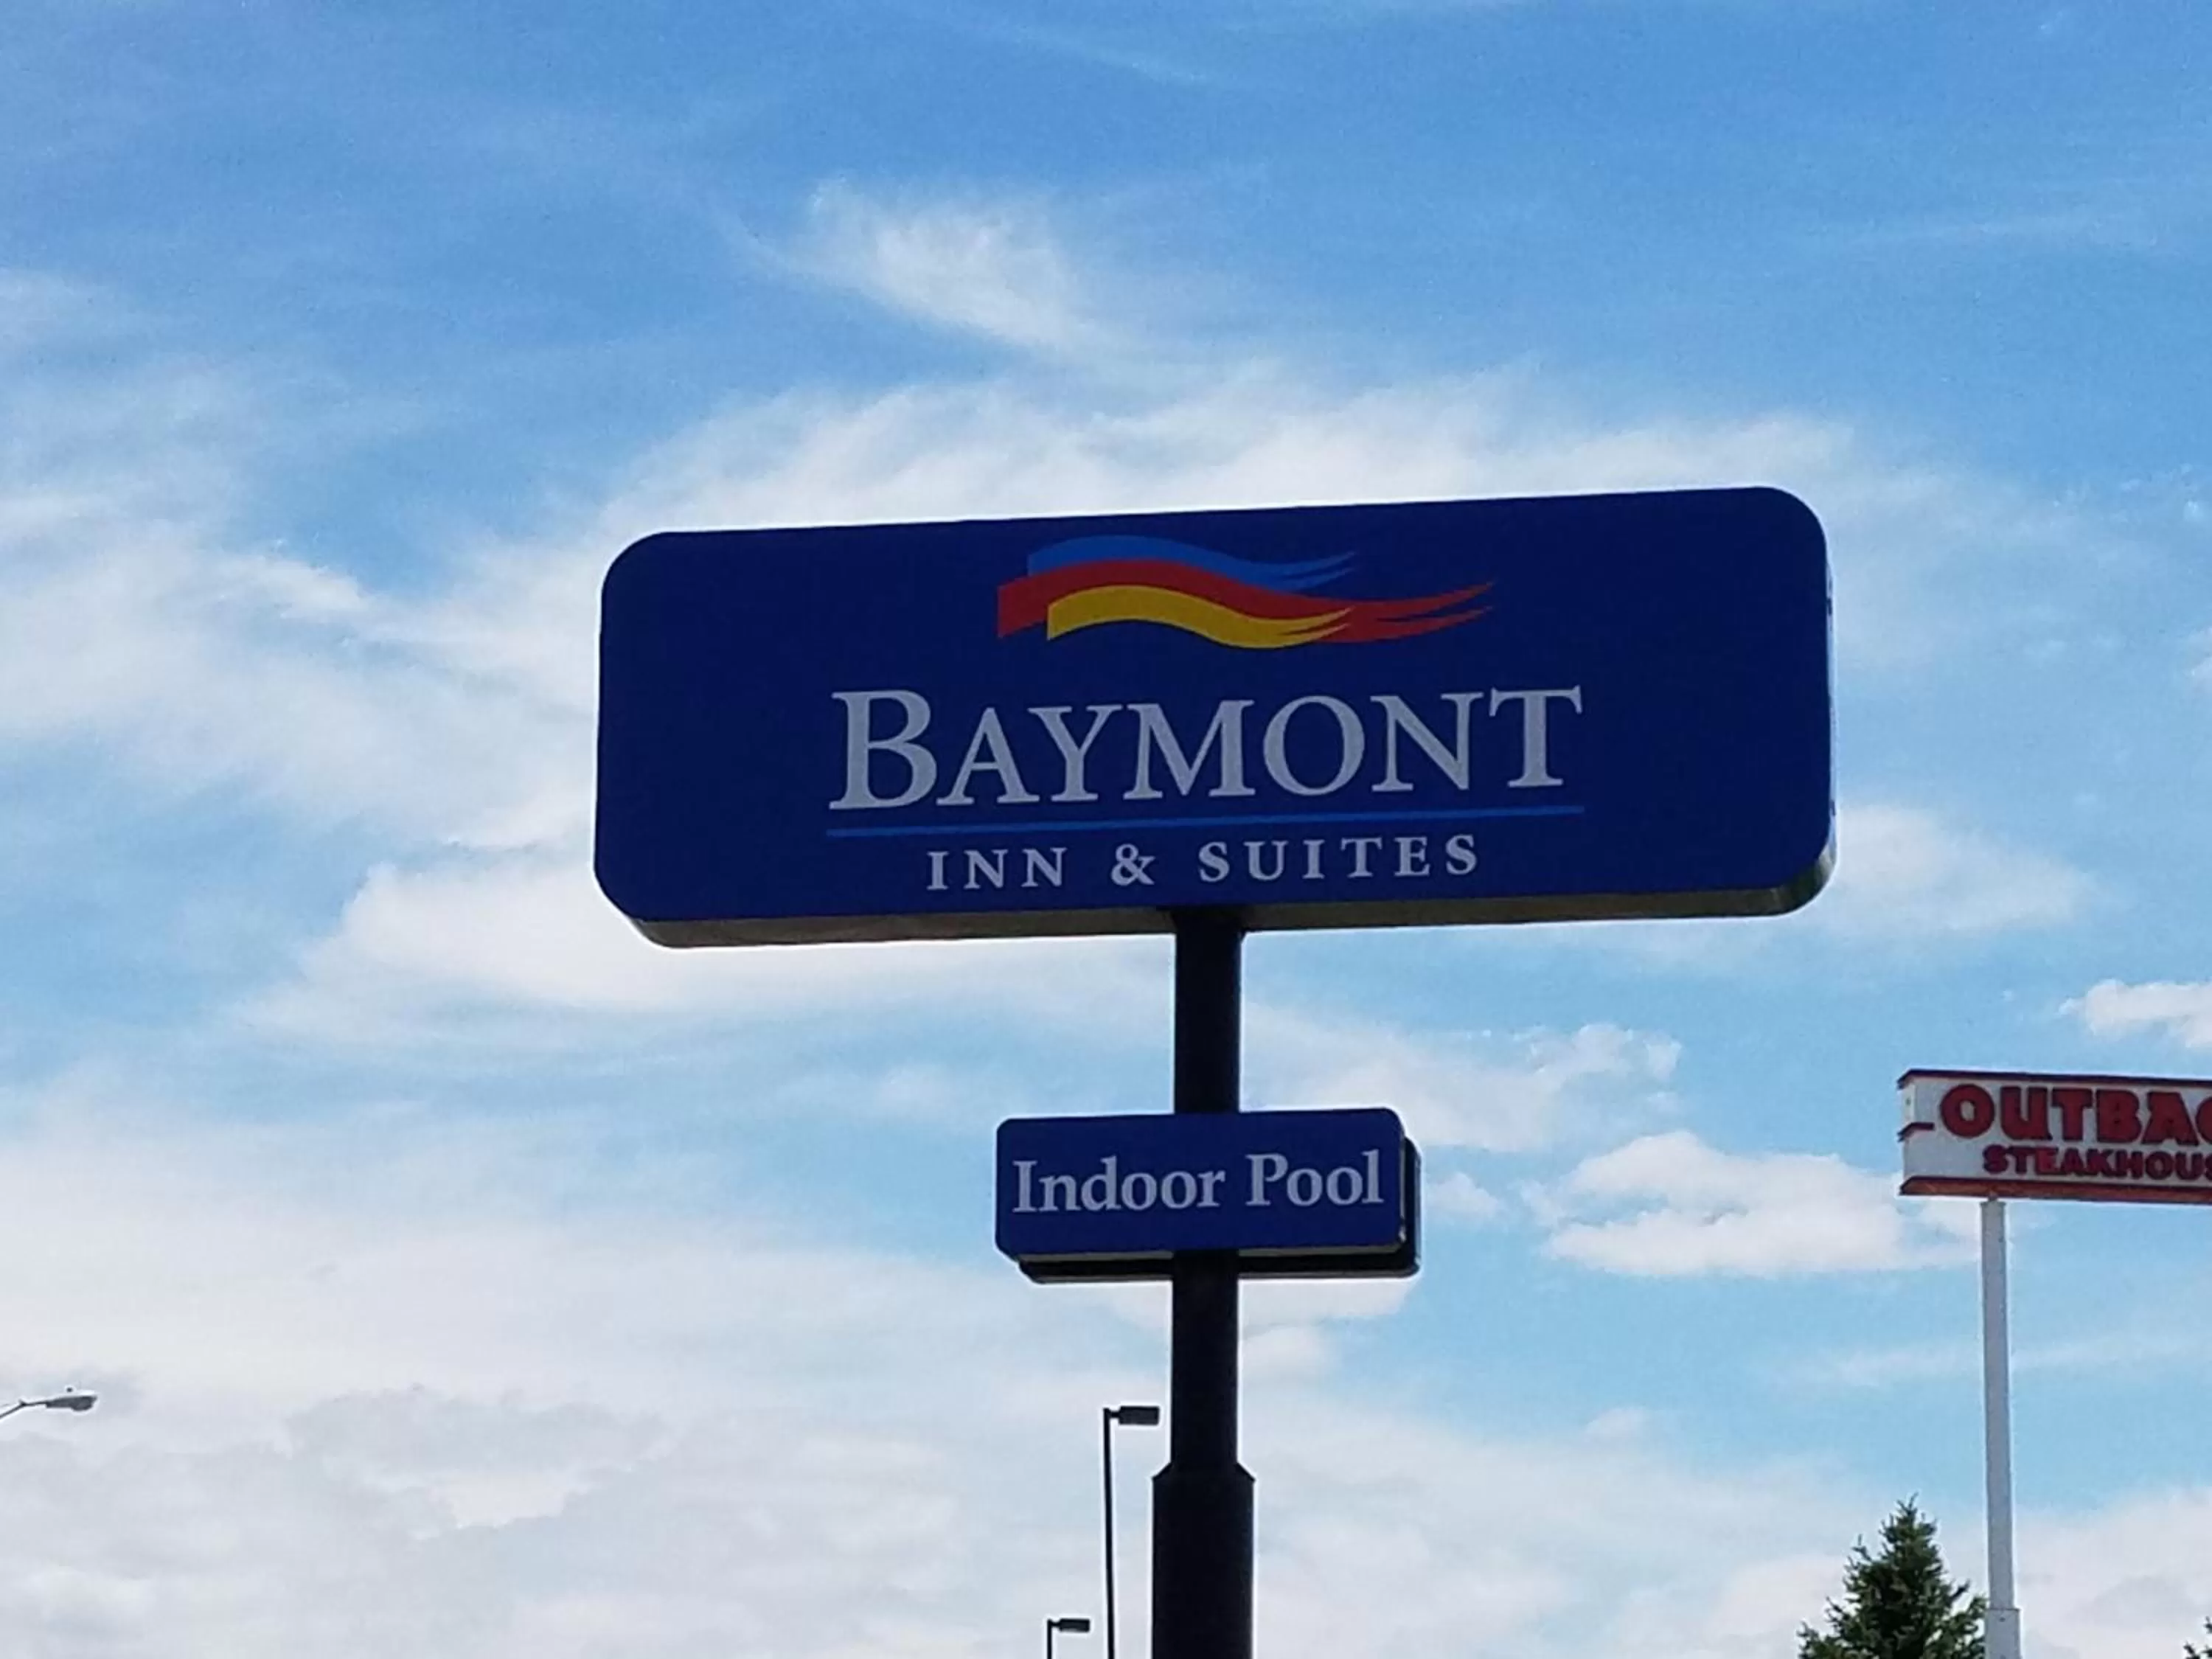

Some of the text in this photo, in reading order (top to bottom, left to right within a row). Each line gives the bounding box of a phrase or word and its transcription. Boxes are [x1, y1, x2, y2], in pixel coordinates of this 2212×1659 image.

[828, 685, 1583, 810] BAYMONT
[927, 834, 1477, 890] INN & SUITES
[1012, 1149, 1384, 1213] Indoor Pool
